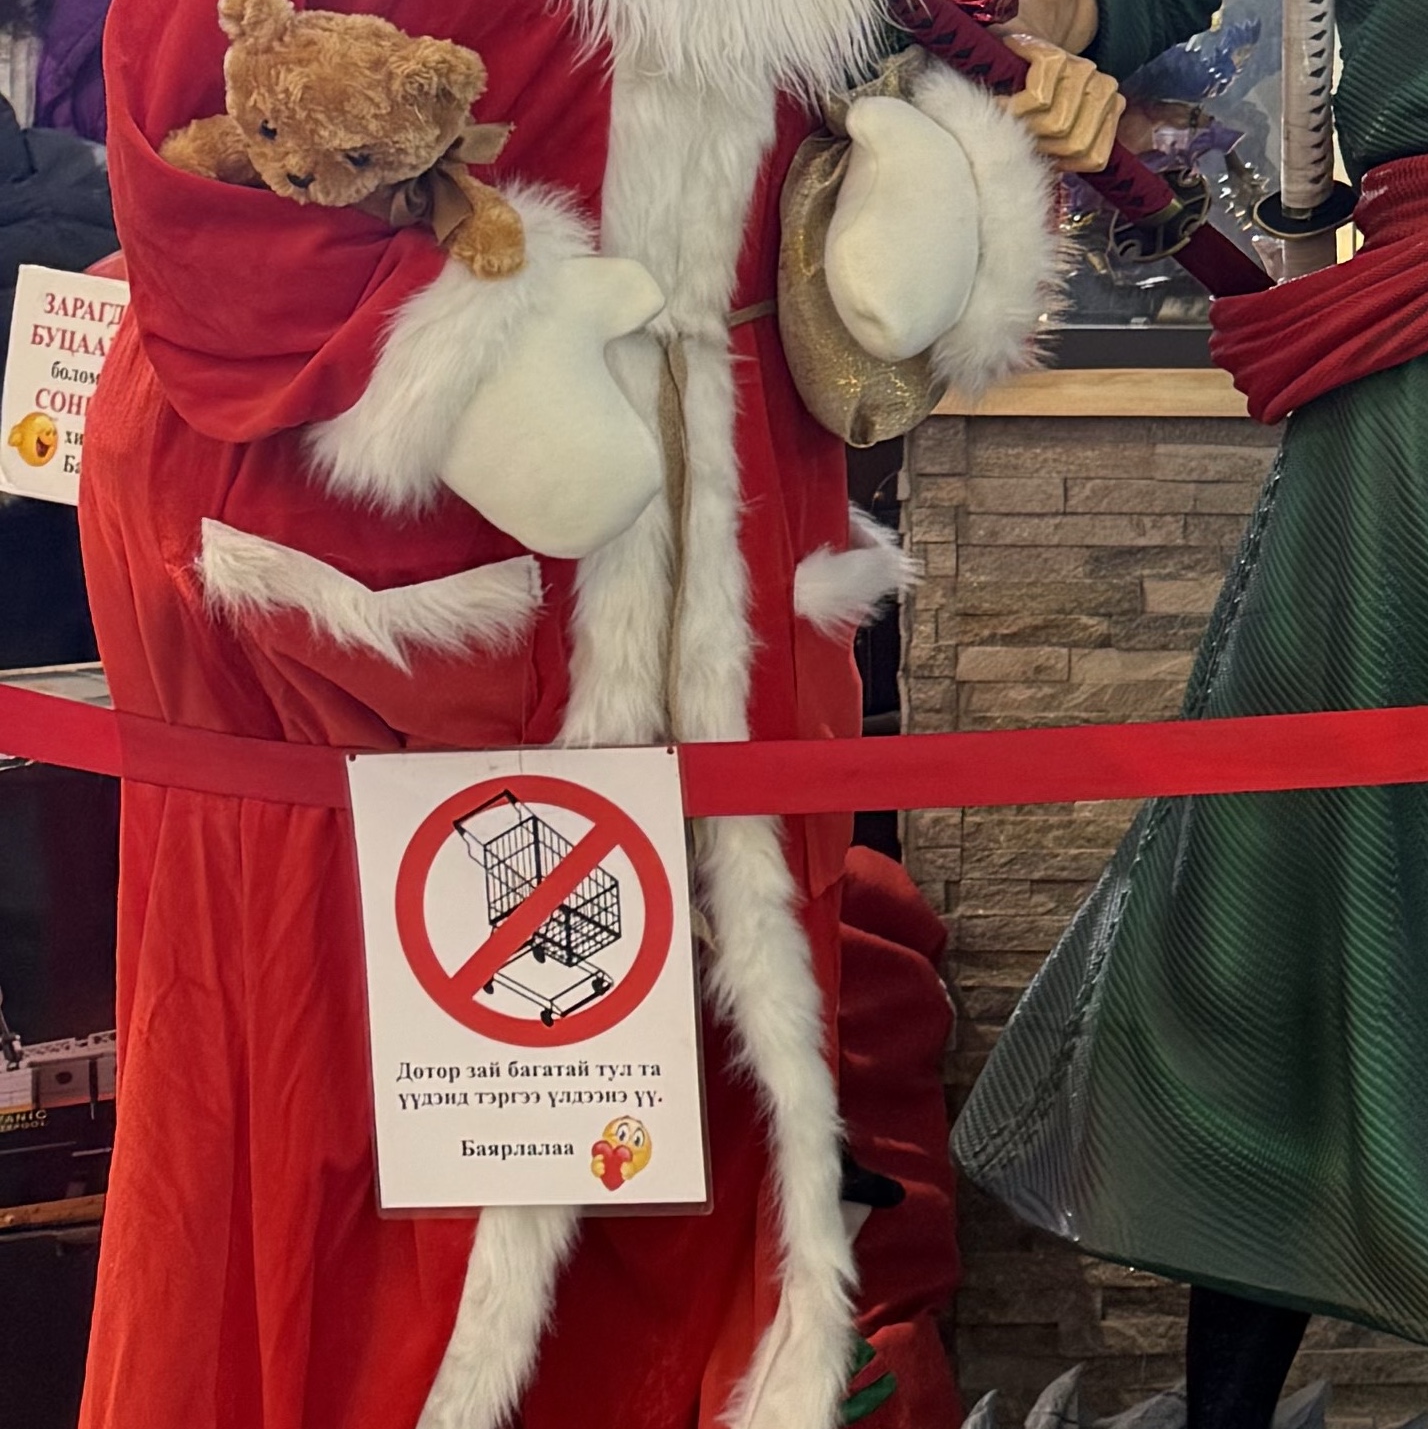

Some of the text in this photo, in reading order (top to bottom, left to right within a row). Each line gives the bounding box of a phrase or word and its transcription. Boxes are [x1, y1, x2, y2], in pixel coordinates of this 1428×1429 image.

[31, 323, 115, 357] БУЦАА
[396, 1060, 661, 1083] Дотор зай багатай тул та
[474, 1090, 541, 1109] тэргээ
[547, 1089, 628, 1108] үлдээнэ
[461, 1139, 575, 1160] Баярлалаа
